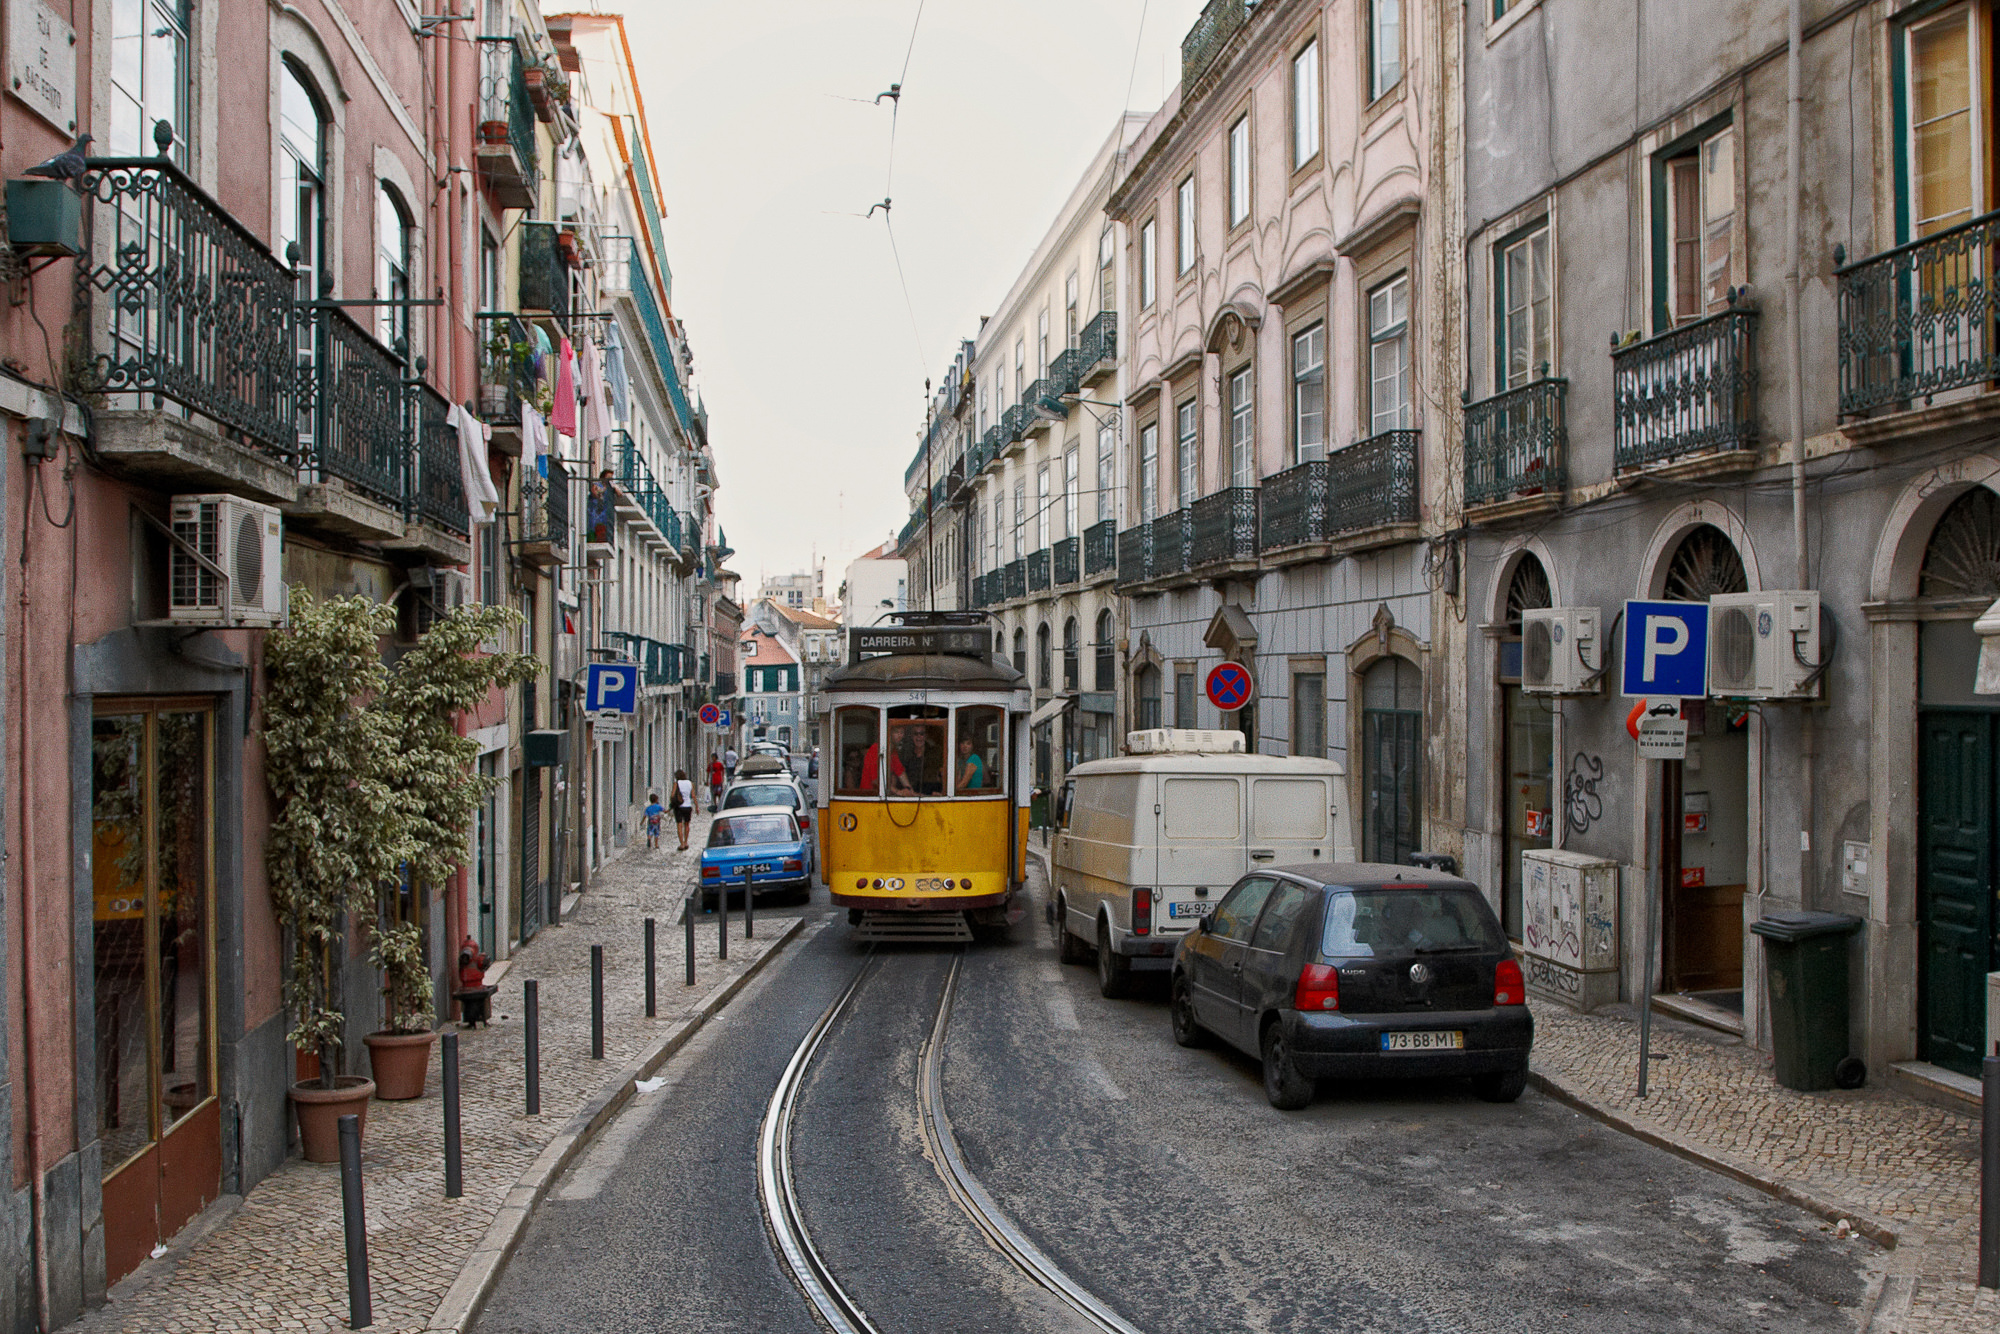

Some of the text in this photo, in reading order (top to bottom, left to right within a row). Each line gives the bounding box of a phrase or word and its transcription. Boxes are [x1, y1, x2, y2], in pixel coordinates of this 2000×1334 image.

[39, 46, 48, 68] DE
[41, 78, 61, 109] BENTO
[860, 636, 917, 647] CARREIRA
[949, 633, 973, 649] 28
[1643, 615, 1689, 682] P
[597, 671, 625, 705] P
[908, 692, 925, 701] 549
[733, 862, 771, 875] BP-5-64
